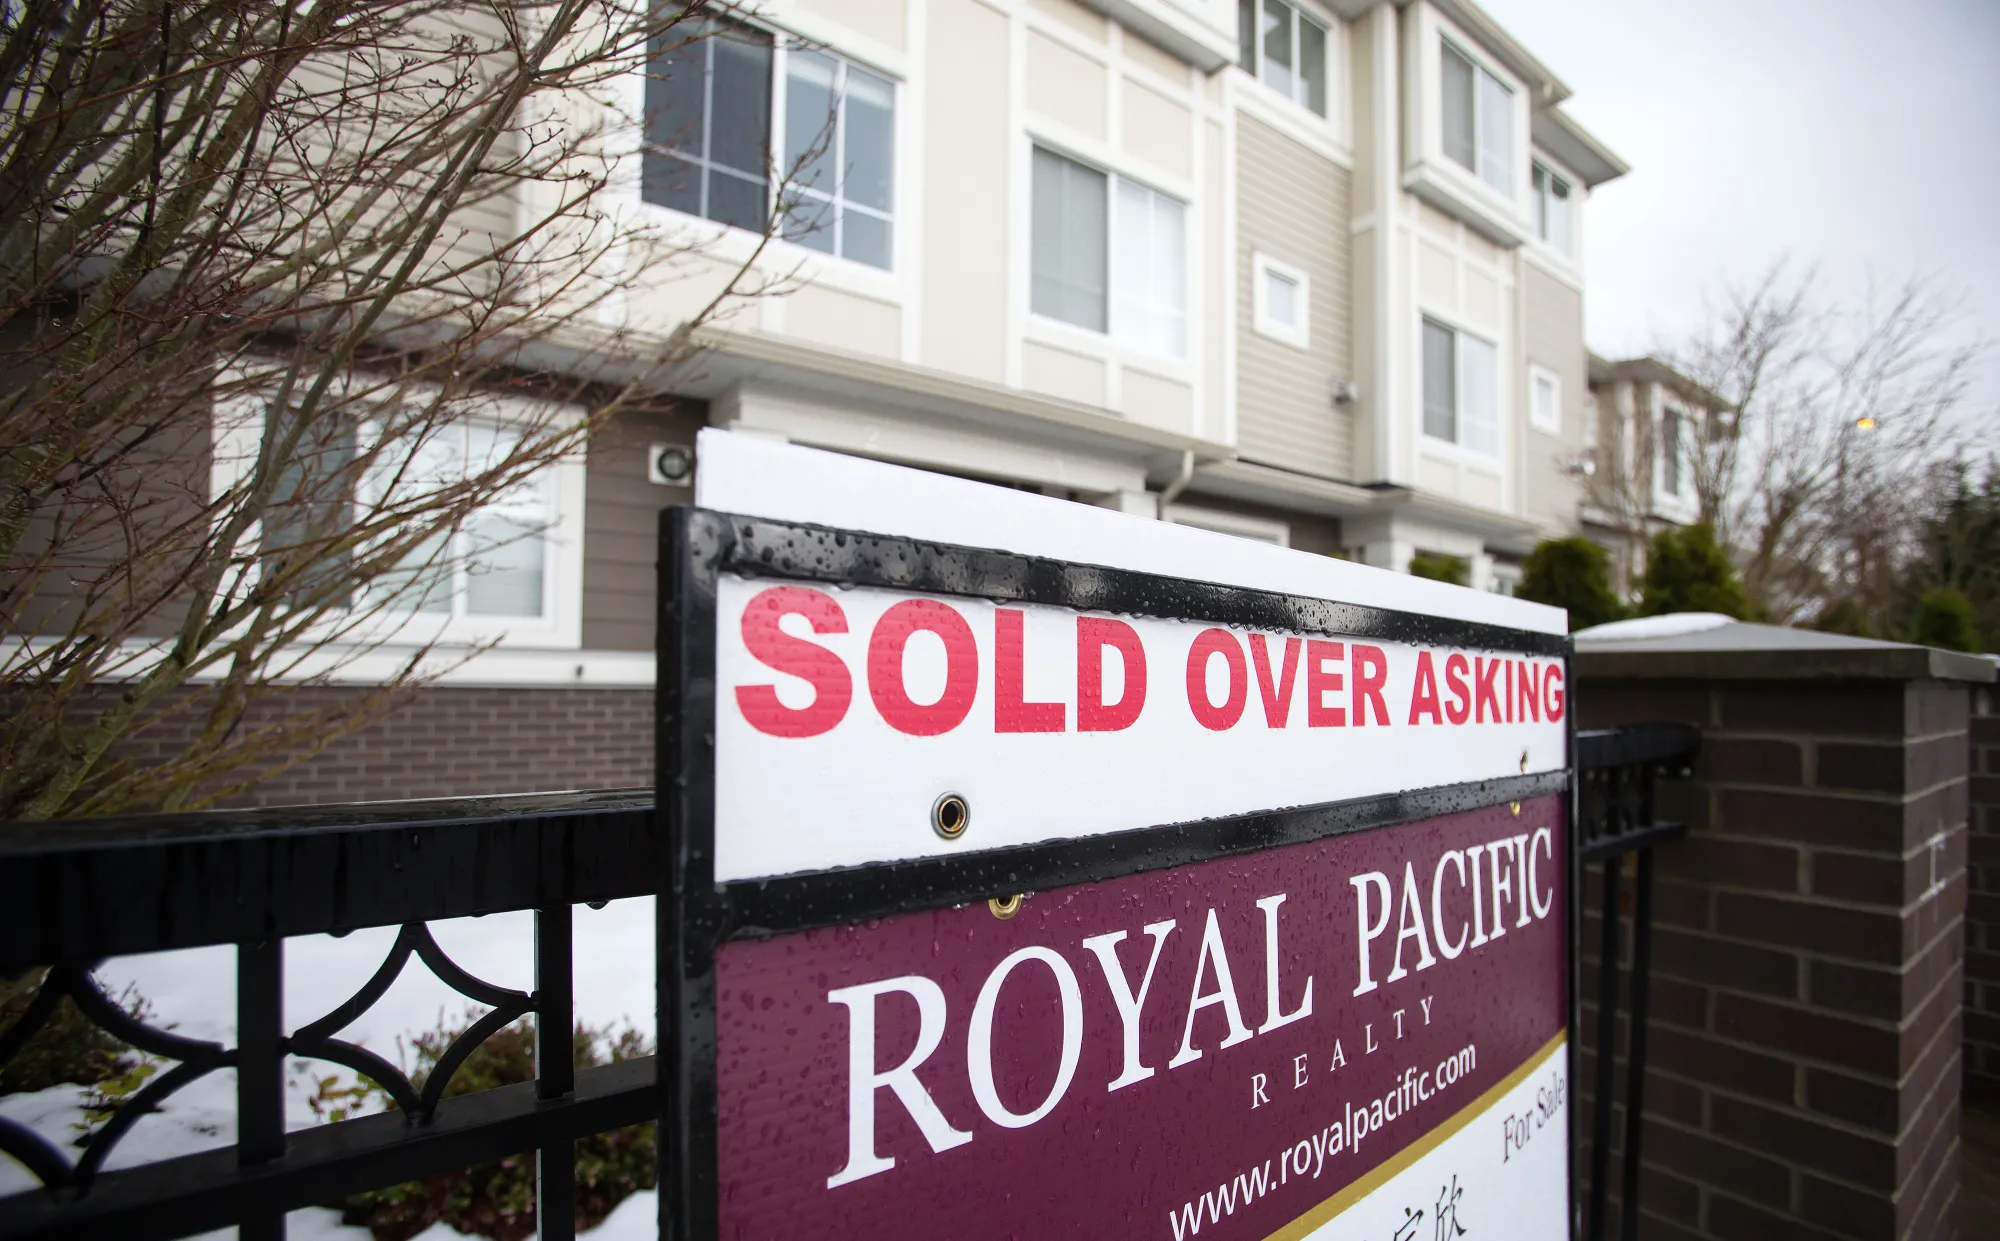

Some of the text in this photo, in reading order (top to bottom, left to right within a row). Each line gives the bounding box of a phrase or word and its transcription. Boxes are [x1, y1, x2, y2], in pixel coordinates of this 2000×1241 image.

[734, 586, 1565, 739] SOLD OVER ASKING
[827, 826, 1553, 1190] ROYAL PACIFIC
[1250, 995, 1434, 1110] REALTY
[1169, 1043, 1476, 1241] www.royalpacific.com
[1503, 1071, 1565, 1164] For Sale
